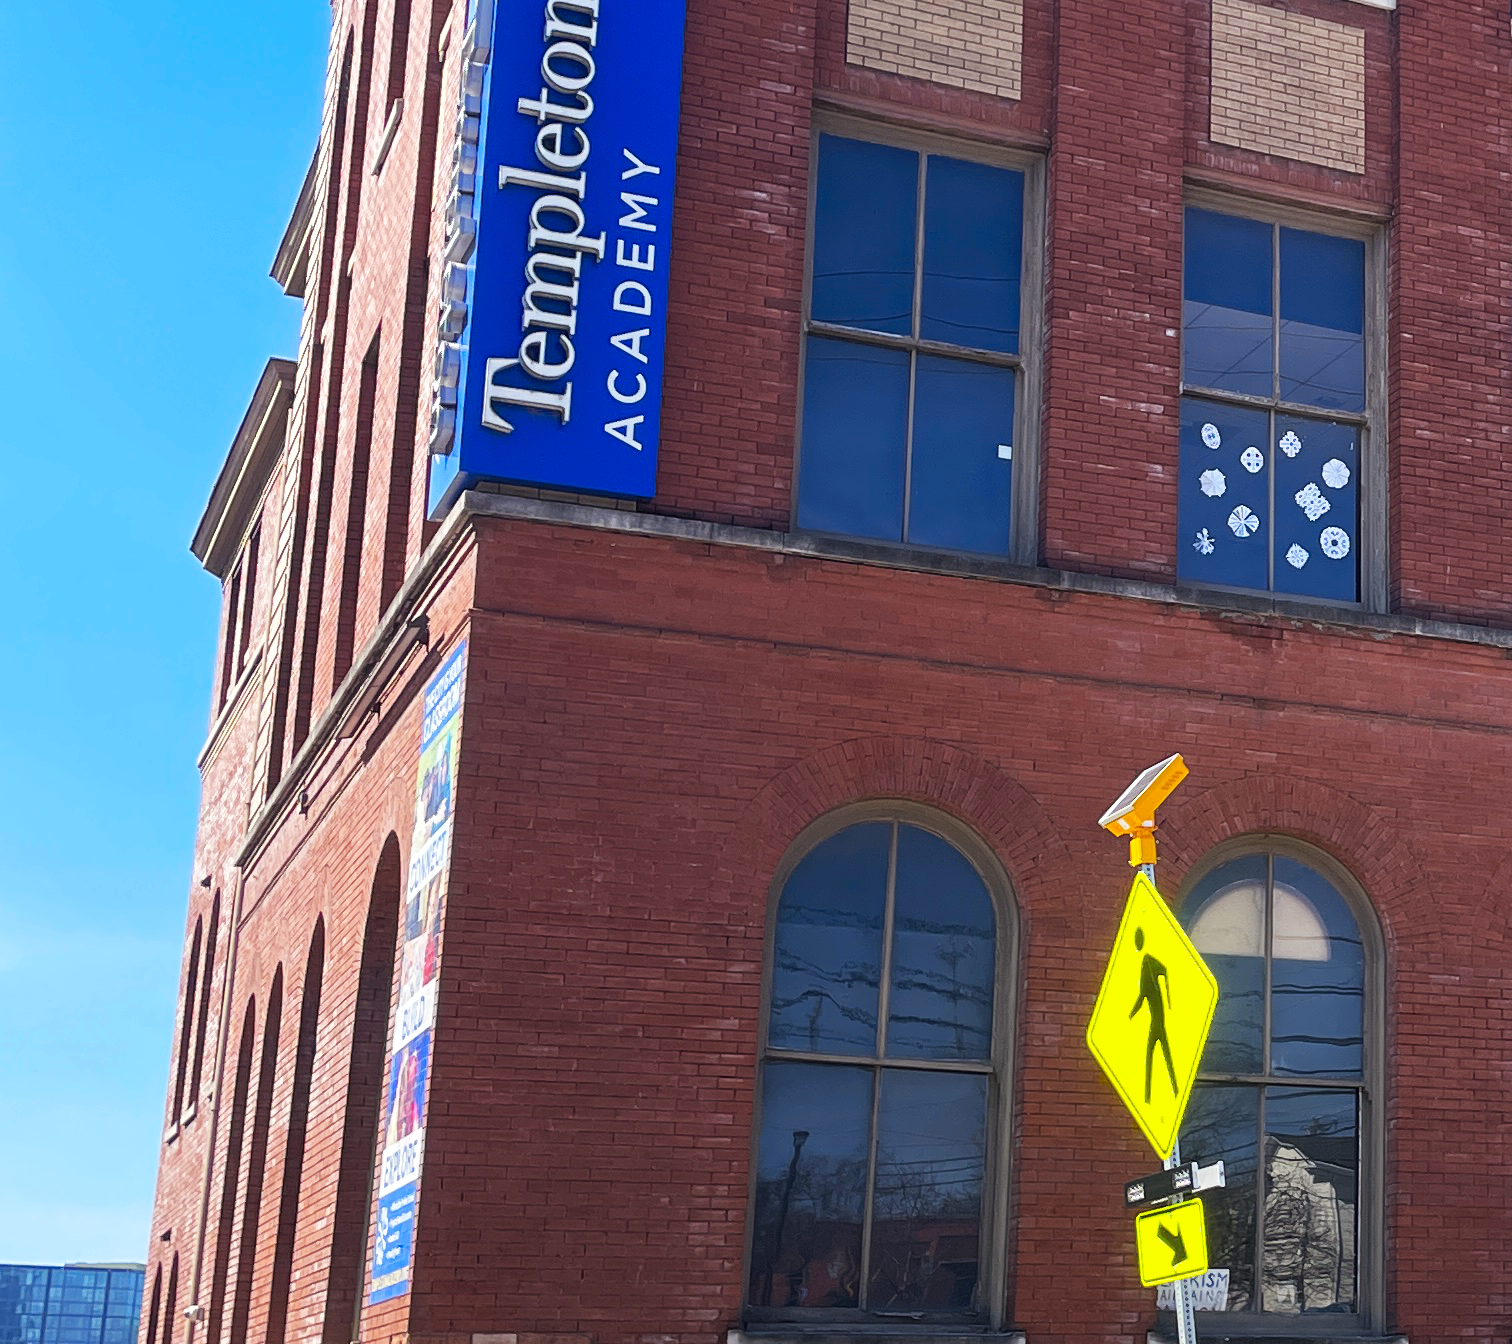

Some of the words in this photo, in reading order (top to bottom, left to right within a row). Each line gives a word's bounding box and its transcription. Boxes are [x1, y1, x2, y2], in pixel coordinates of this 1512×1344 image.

[604, 147, 662, 451] ACADEMY
[409, 829, 447, 894] CONNECT
[383, 1139, 418, 1188] EXPLORE
